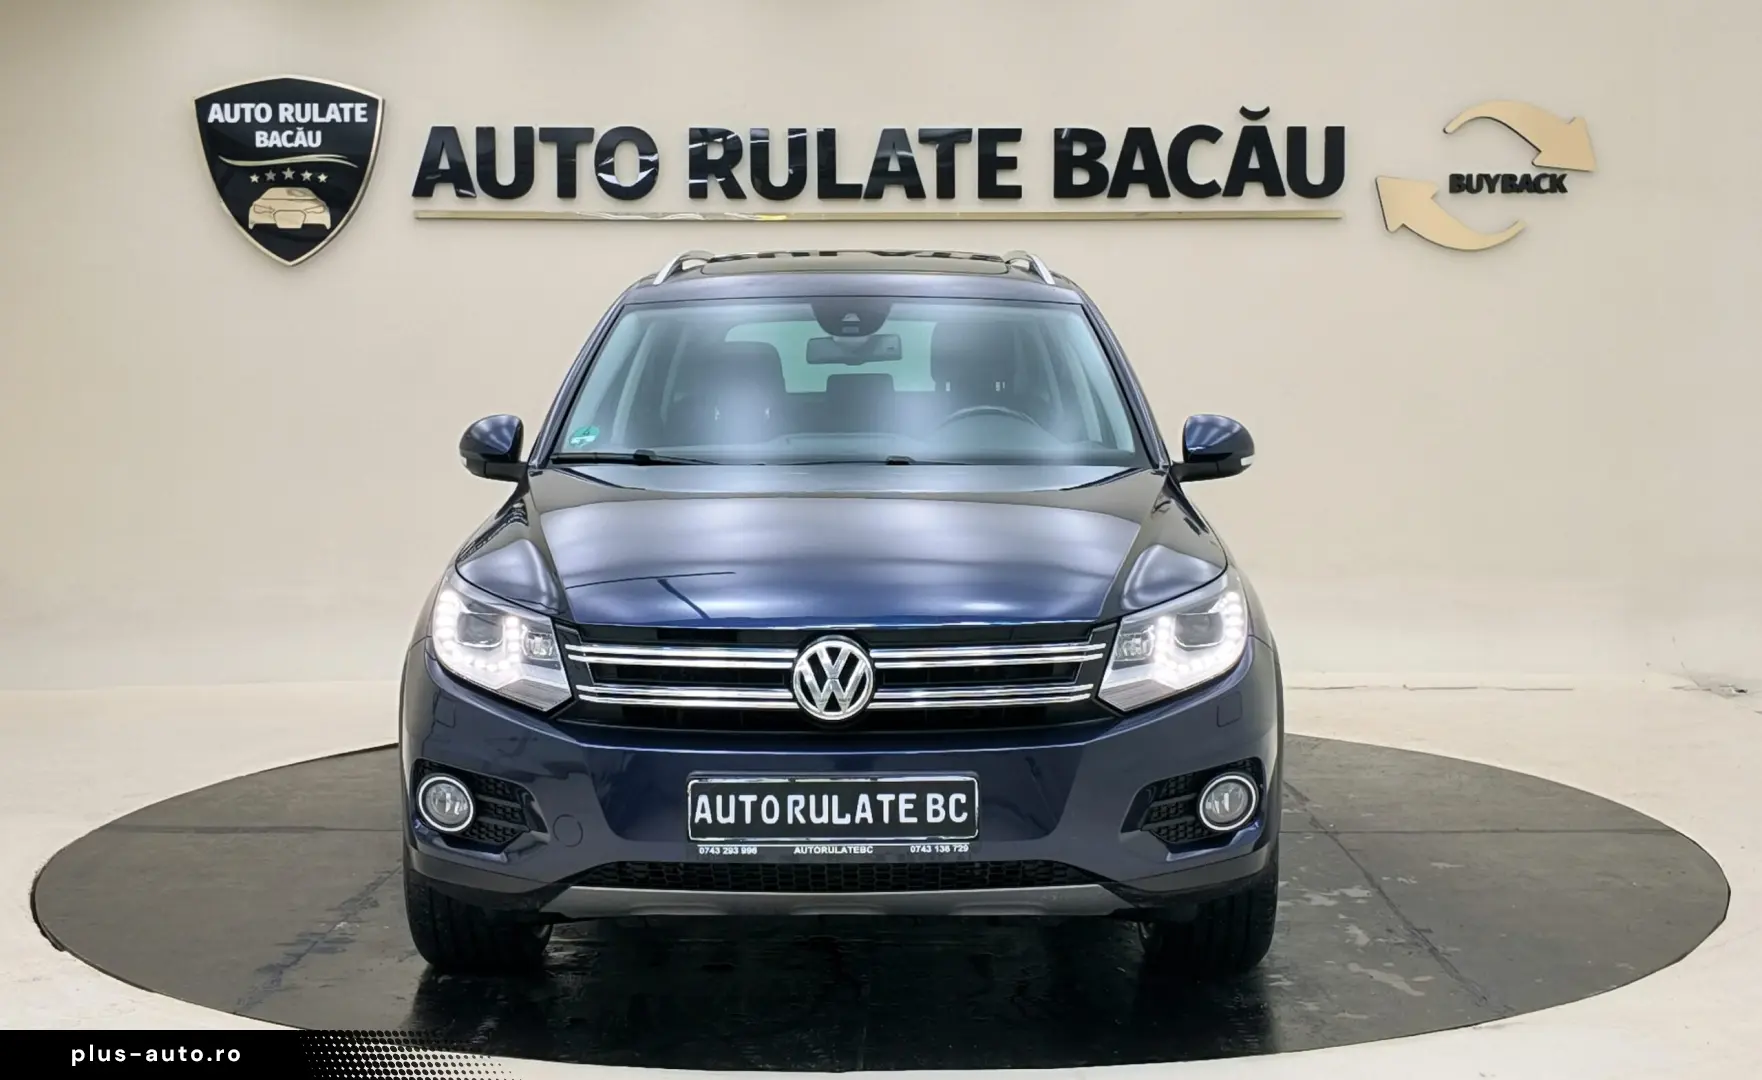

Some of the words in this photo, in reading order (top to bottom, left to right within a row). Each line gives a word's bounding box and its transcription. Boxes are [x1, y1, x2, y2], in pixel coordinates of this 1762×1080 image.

[207, 103, 273, 123] AUTO
[278, 103, 369, 123] RULATE
[255, 127, 322, 148] BACĂU
[412, 125, 660, 200] AUTO
[688, 127, 1023, 200] RULATE
[1053, 105, 1346, 200] BACĂU
[1448, 173, 1568, 194] BUYBACK
[694, 794, 780, 824] AUTO
[787, 793, 918, 824] RULATE
[926, 792, 969, 823] BC
[698, 846, 721, 855] 0743
[793, 845, 874, 854] AUTORULATEBC
[910, 845, 932, 854] 0743
